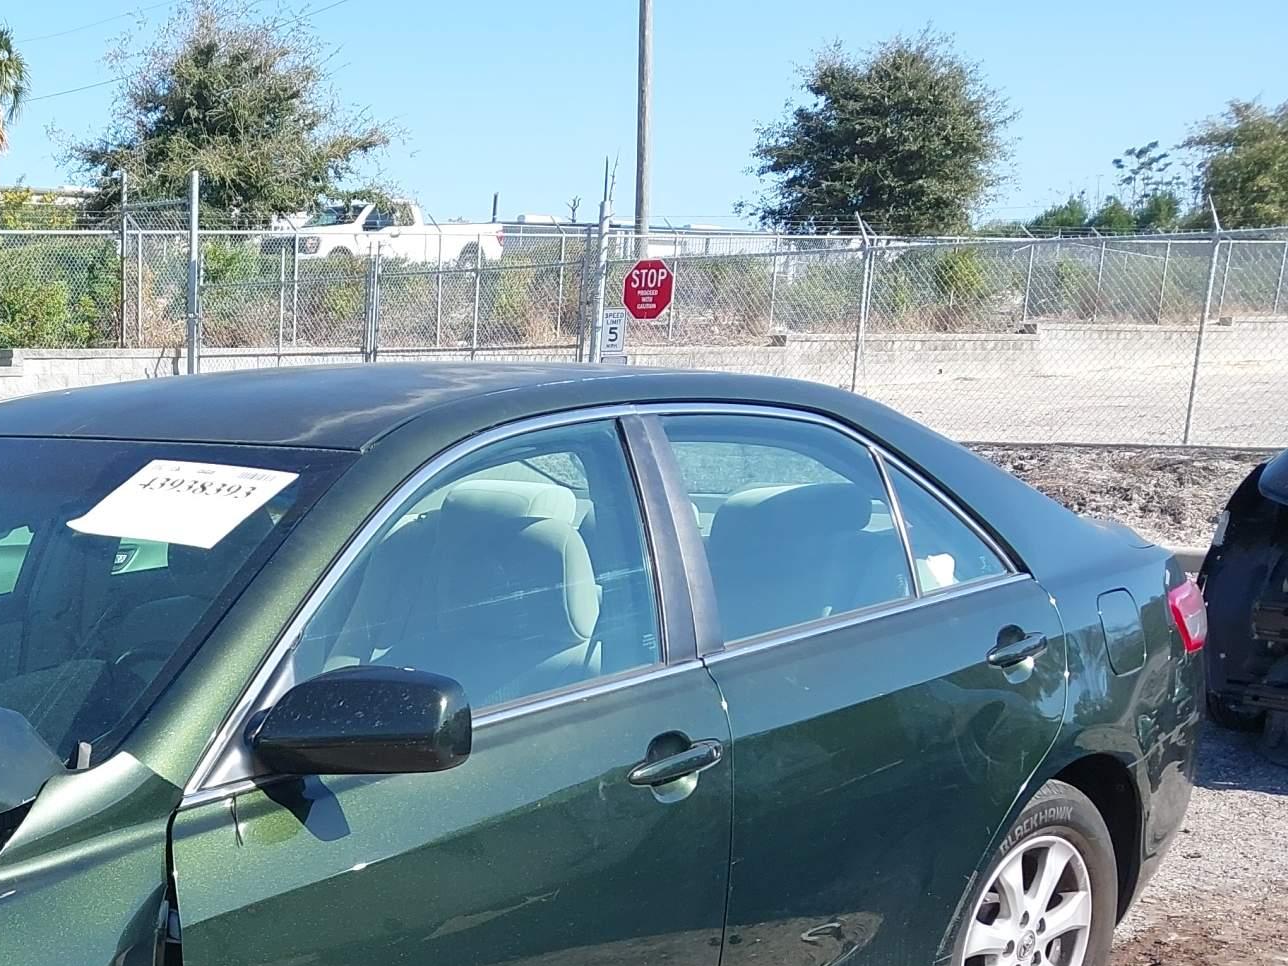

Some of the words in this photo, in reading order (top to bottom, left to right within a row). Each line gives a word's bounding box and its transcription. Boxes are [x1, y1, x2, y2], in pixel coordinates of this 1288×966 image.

[631, 268, 668, 289] STOP
[608, 326, 618, 342] 5
[138, 476, 257, 499] 43938393
[999, 806, 1073, 856] BLACKHAWK
